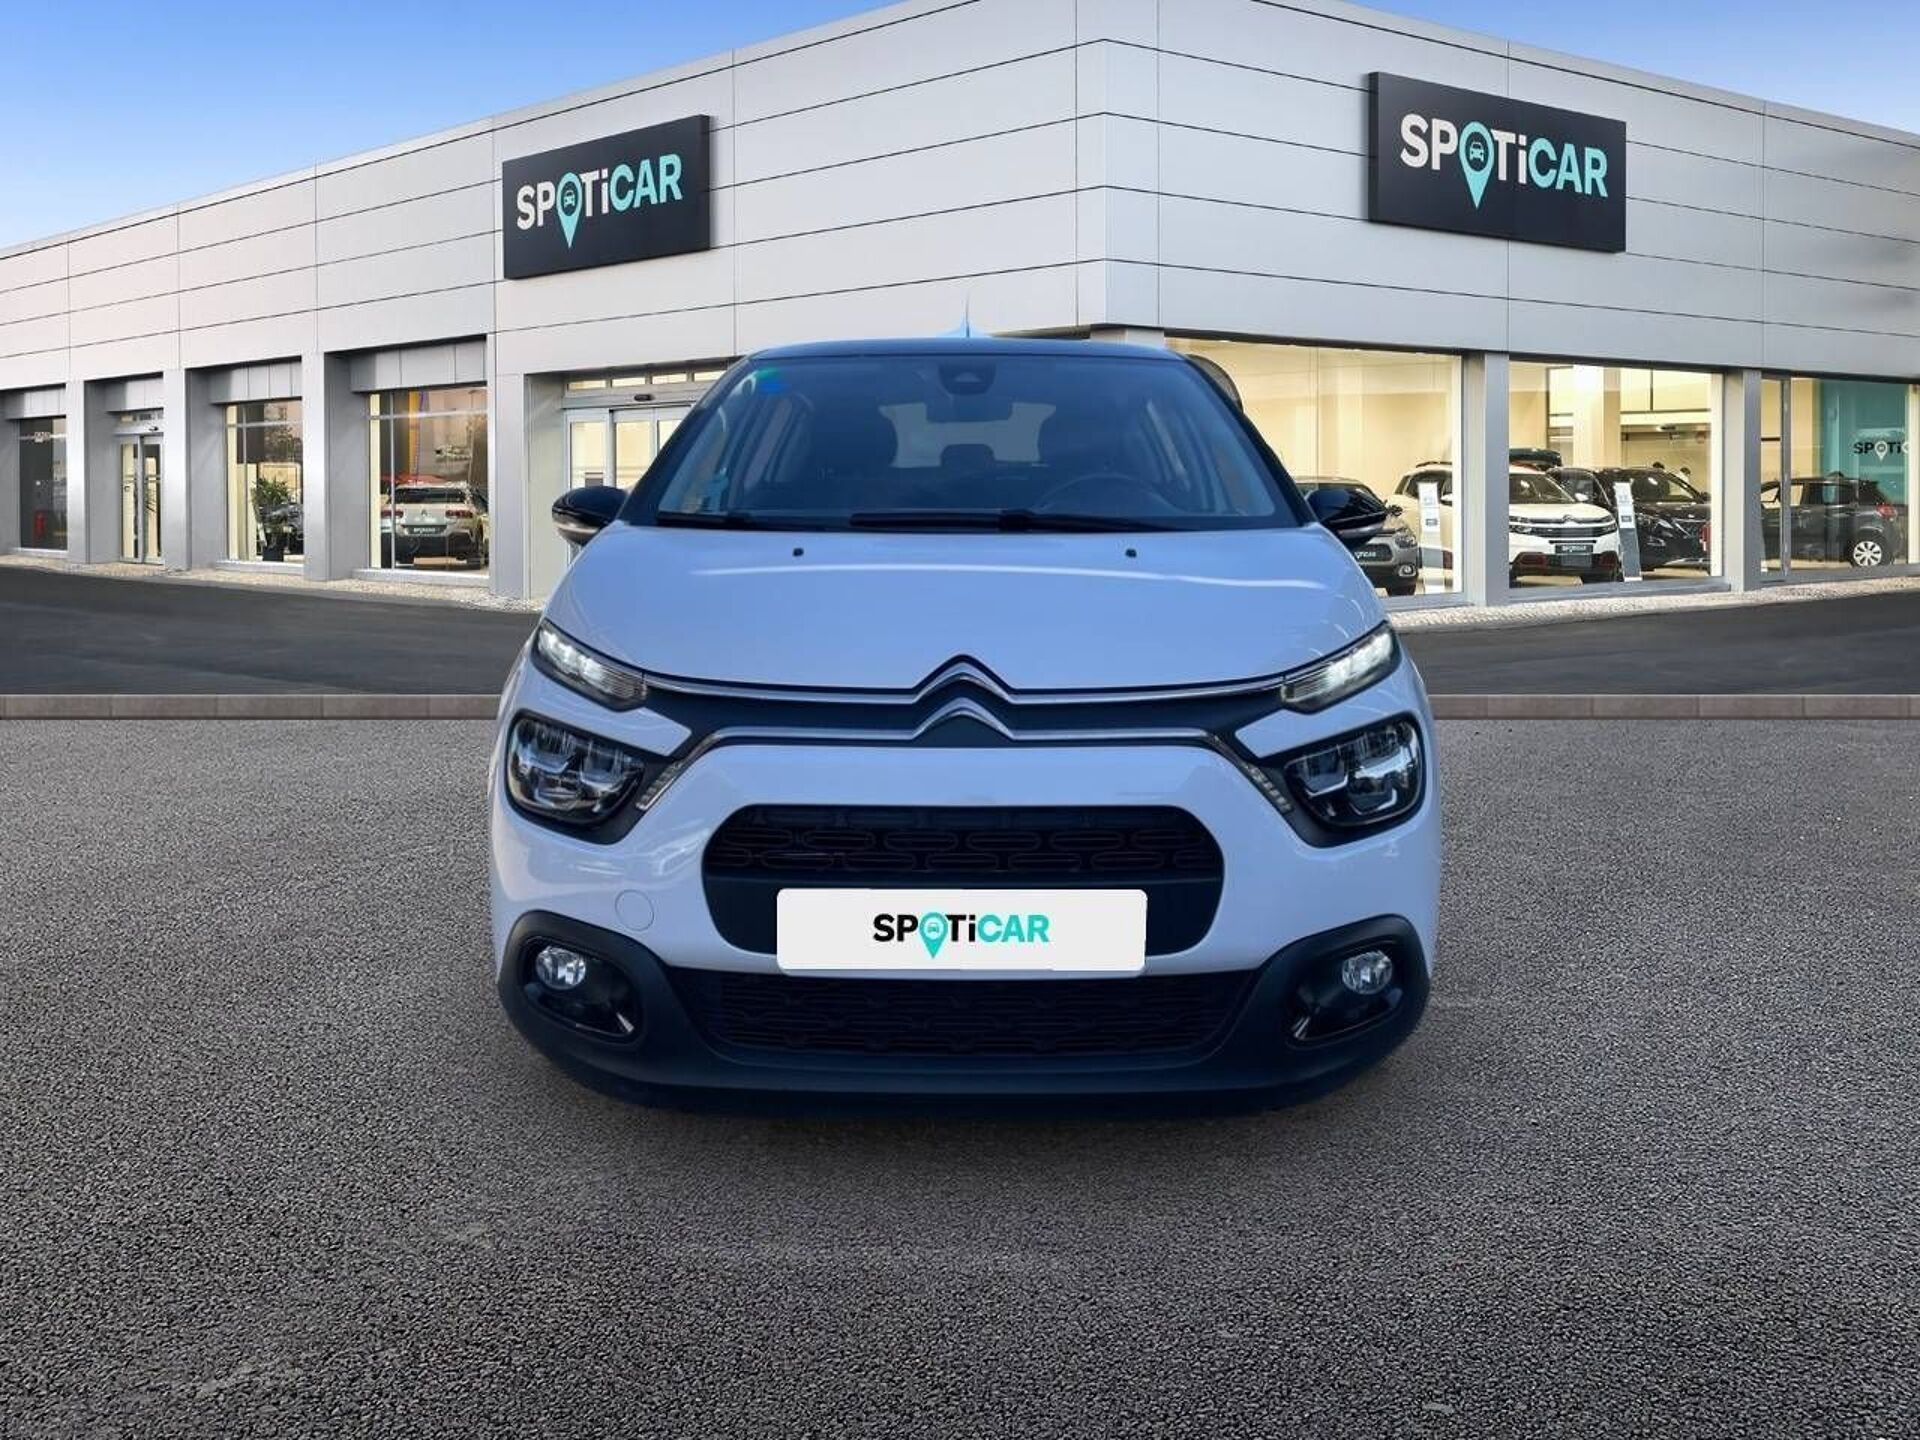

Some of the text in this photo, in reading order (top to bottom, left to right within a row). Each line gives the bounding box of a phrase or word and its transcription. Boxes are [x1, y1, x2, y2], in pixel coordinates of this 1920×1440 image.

[516, 153, 683, 248] SPOTiCAR
[1399, 113, 1609, 209] SPOTiCAR
[872, 911, 1050, 959] SPOTiCAR
